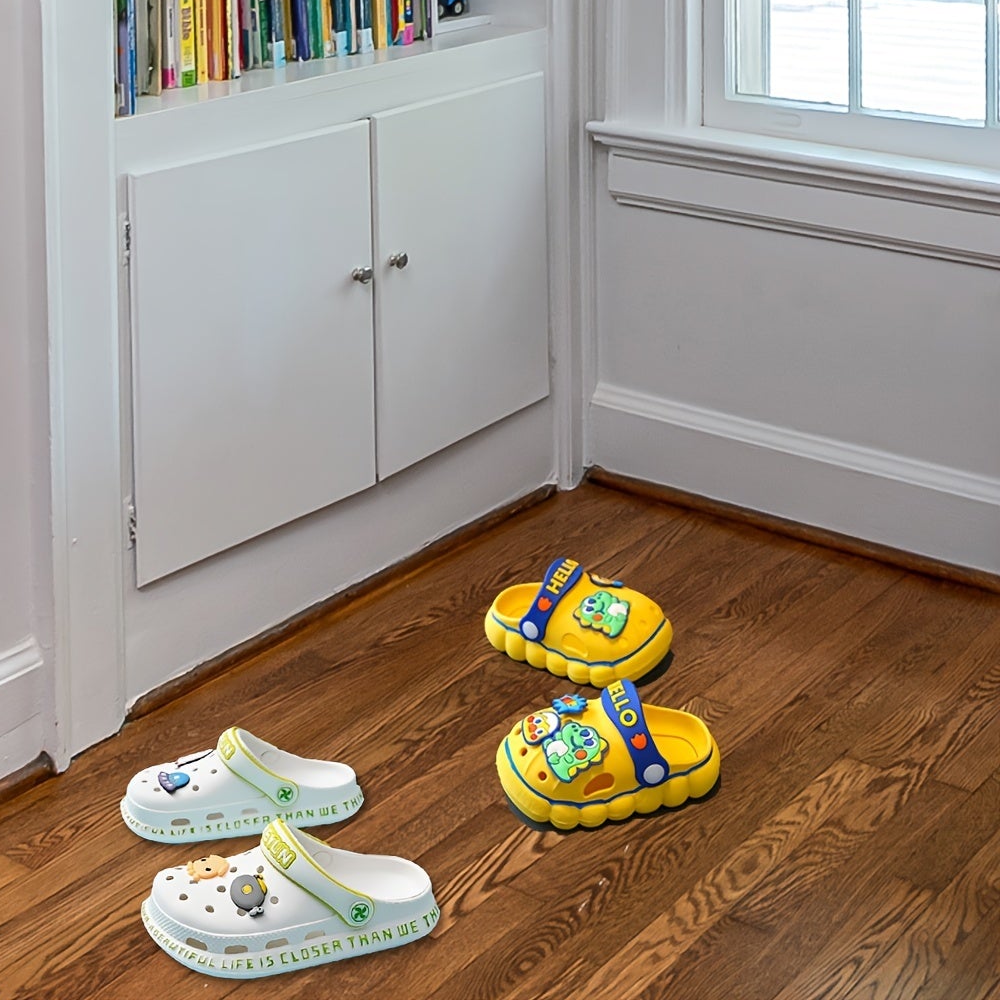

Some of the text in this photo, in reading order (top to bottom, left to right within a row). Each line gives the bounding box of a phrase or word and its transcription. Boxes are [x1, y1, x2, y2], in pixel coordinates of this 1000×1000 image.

[319, 804, 338, 817] WE
[222, 958, 254, 969] LIFE
[260, 955, 274, 967] IS
[280, 940, 343, 964] CLOSER
[347, 928, 393, 949] THAN
[397, 920, 419, 937] WE
